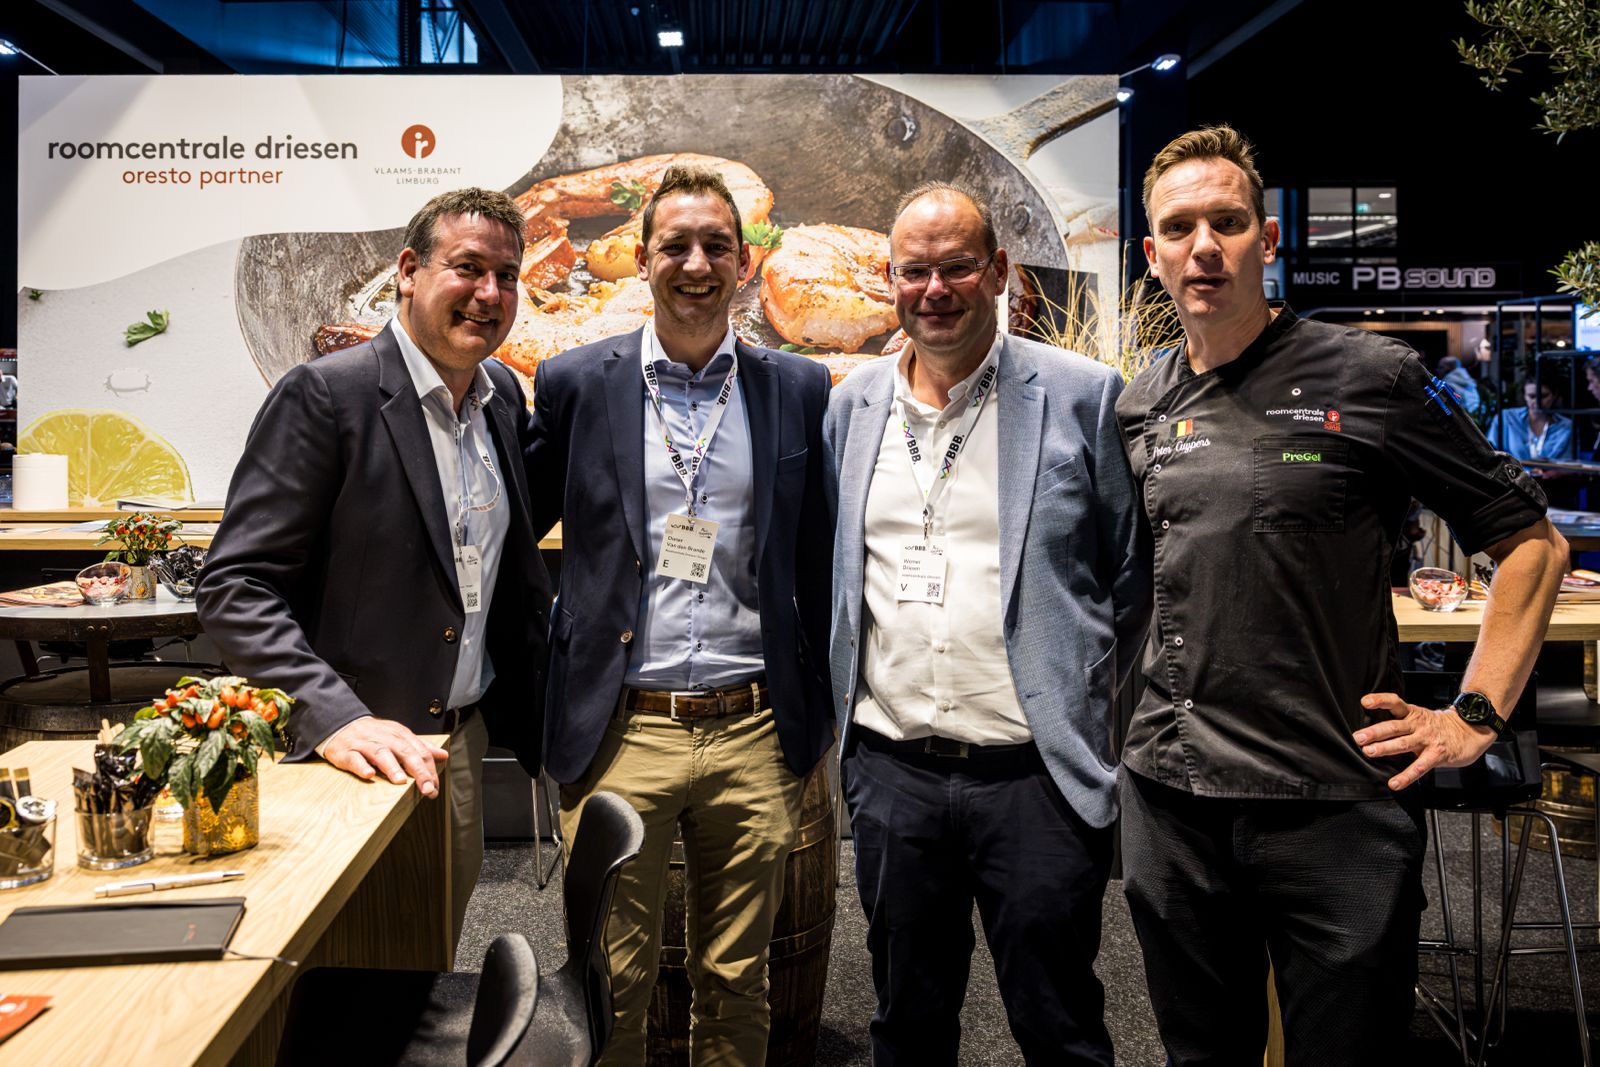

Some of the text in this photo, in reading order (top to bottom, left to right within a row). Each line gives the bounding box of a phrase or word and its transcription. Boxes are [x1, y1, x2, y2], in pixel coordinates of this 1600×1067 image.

[48, 135, 358, 160] roomcentrale driesen
[374, 167, 462, 175] VLAAMS-BRABANT
[122, 167, 283, 190] oresto partner
[1293, 272, 1341, 285] MUSIC
[1352, 267, 1401, 290] PB
[1266, 407, 1325, 417] roomcentrale
[1293, 413, 1325, 423] driesen
[1282, 452, 1321, 462] PreGel
[663, 559, 669, 568] E
